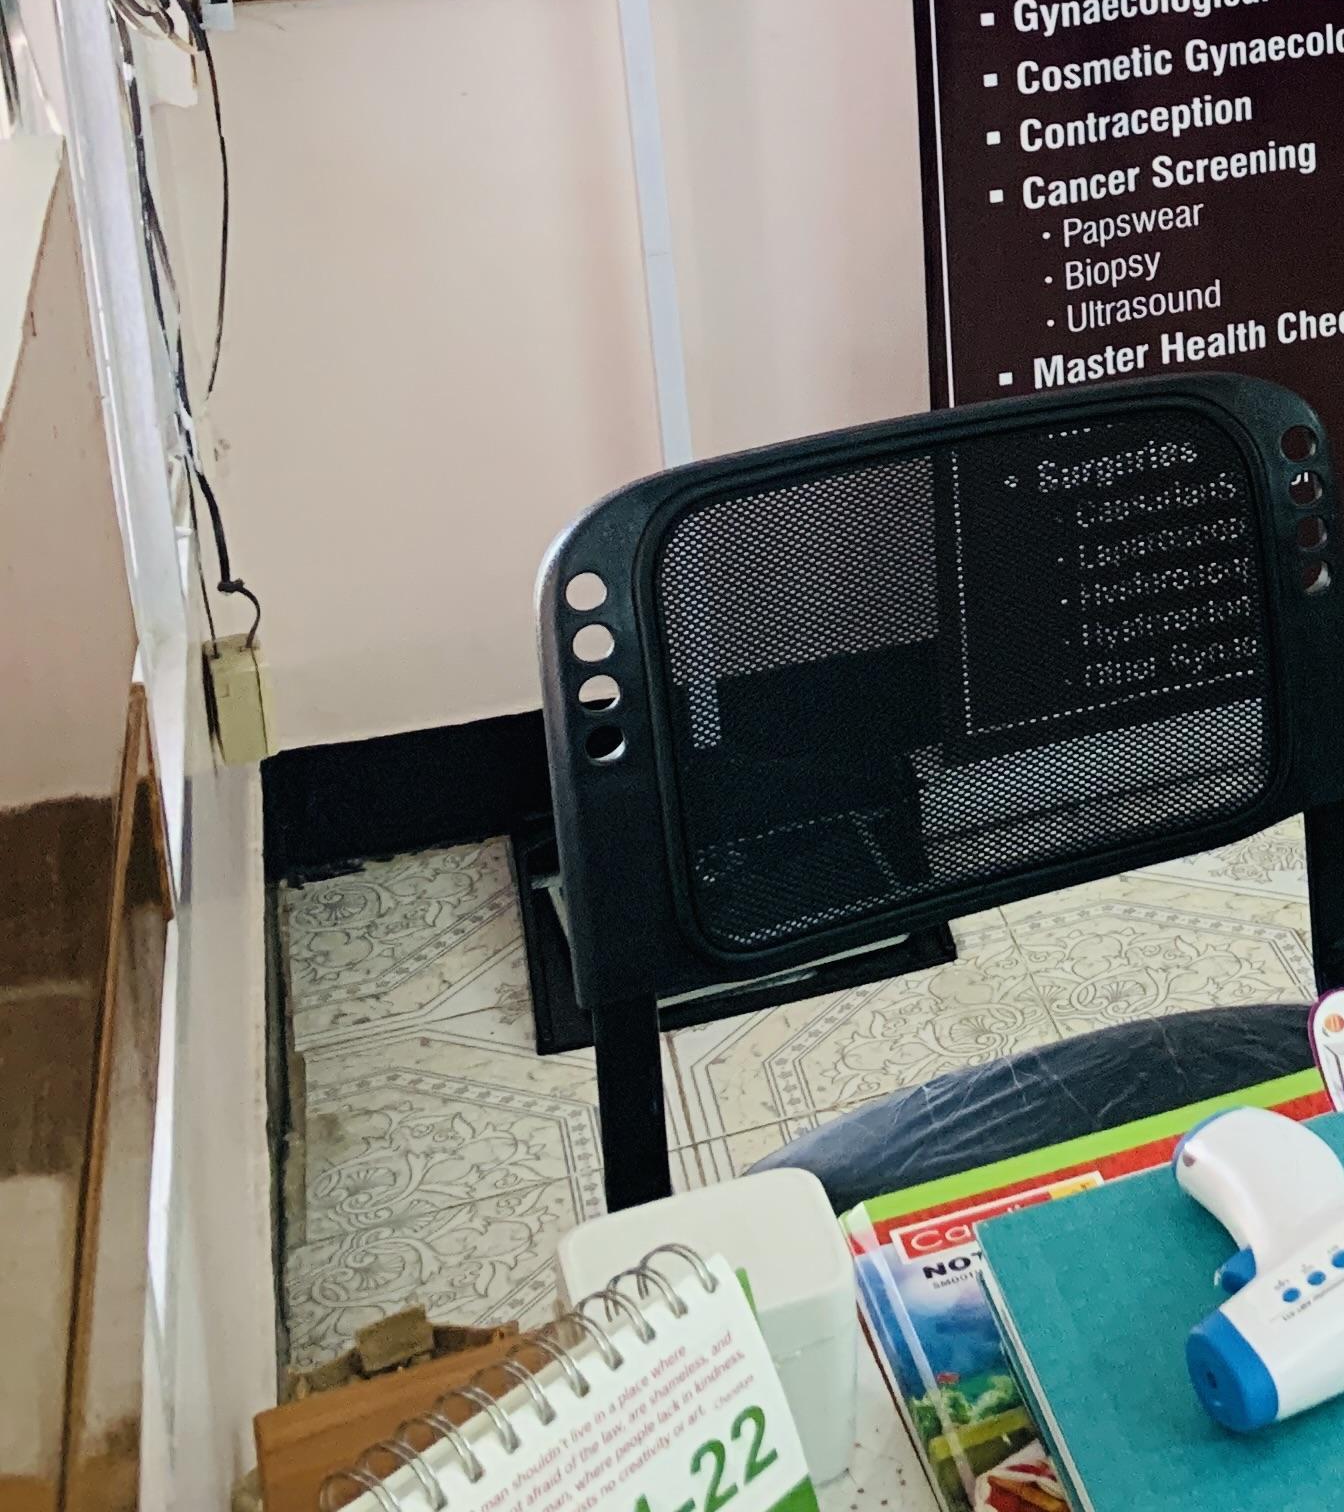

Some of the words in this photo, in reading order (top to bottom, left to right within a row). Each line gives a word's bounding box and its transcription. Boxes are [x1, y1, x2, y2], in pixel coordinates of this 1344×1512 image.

[1016, 44, 1173, 95] Cosmetic
[1019, 94, 1253, 152] Contraception
[1022, 166, 1140, 210] Cancer
[1151, 140, 1317, 189] Screening
[1063, 203, 1204, 248] Papswear
[1065, 251, 1161, 291] Biopsy
[1067, 278, 1221, 333] Ultrasound
[1033, 343, 1149, 390] Master
[1160, 319, 1266, 365] Health
[618, 1374, 649, 1410] place
[650, 1345, 686, 1380] where
[628, 1402, 648, 1425] are
[711, 1329, 732, 1357] and
[575, 1455, 612, 1492] where
[615, 1421, 656, 1465] people
[657, 1398, 681, 1425] lack
